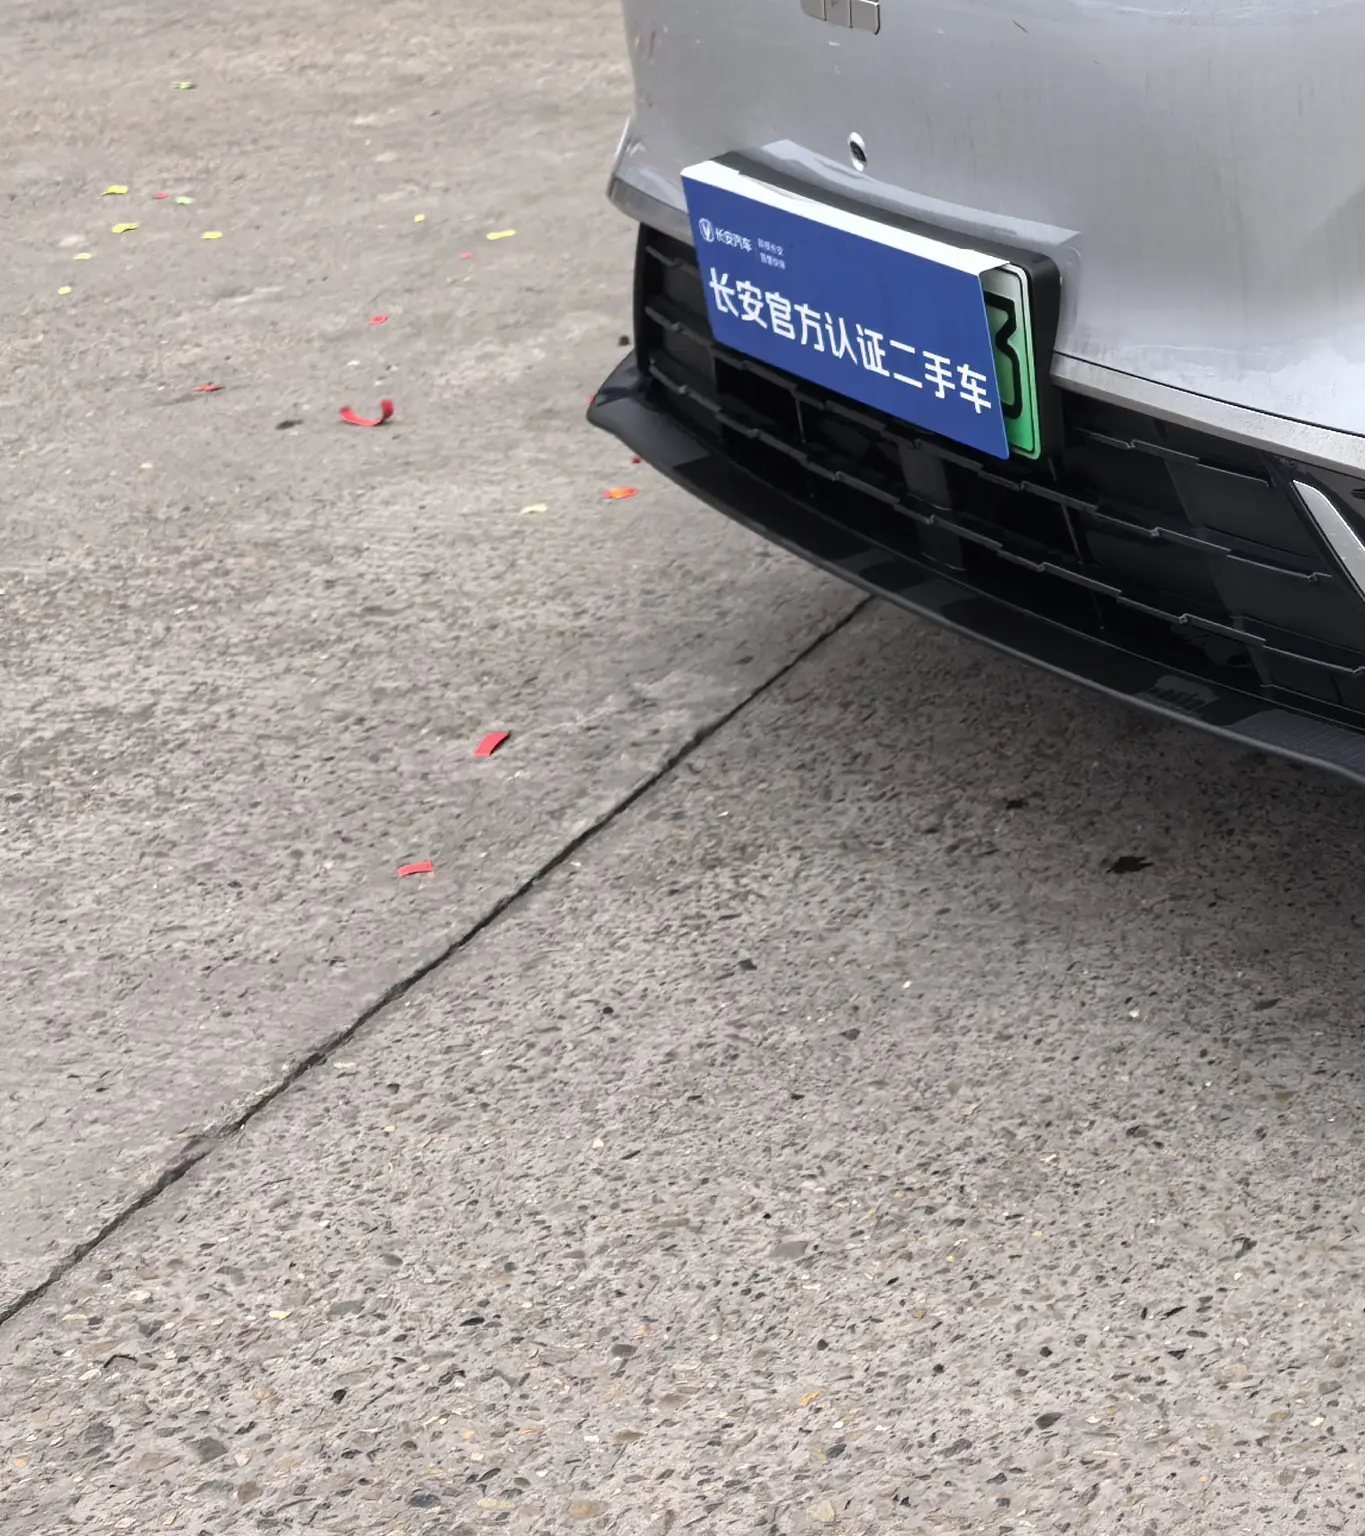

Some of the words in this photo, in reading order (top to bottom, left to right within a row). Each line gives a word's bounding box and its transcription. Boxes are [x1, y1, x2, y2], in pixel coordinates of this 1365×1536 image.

[709, 267, 992, 414] 长安官方认证二手车
